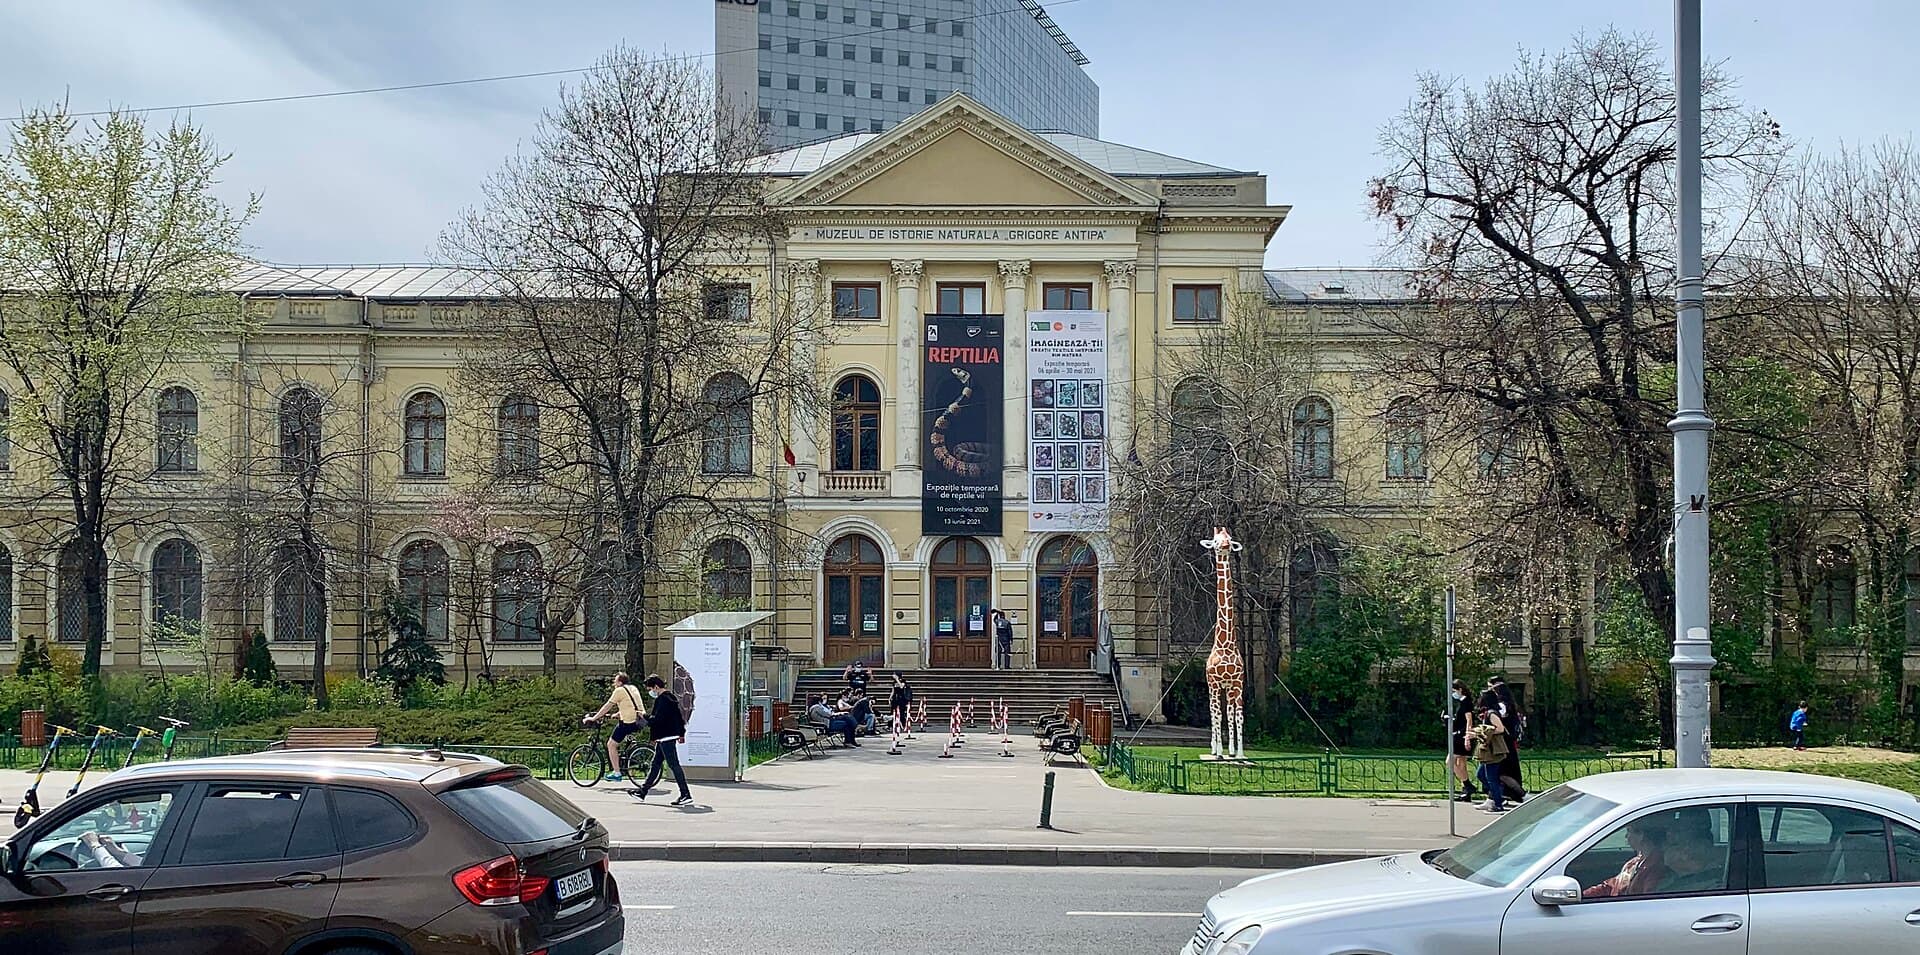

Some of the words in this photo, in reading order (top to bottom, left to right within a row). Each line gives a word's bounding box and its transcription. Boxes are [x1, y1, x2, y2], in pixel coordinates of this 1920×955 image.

[816, 229, 864, 240] MUZEUL
[869, 229, 885, 240] DE
[889, 229, 934, 240] ISTORIE
[928, 347, 1000, 364] REPTILIA
[961, 484, 999, 493] temporară
[940, 491, 950, 499] de
[951, 492, 975, 500] reptile
[559, 881, 567, 896] B
